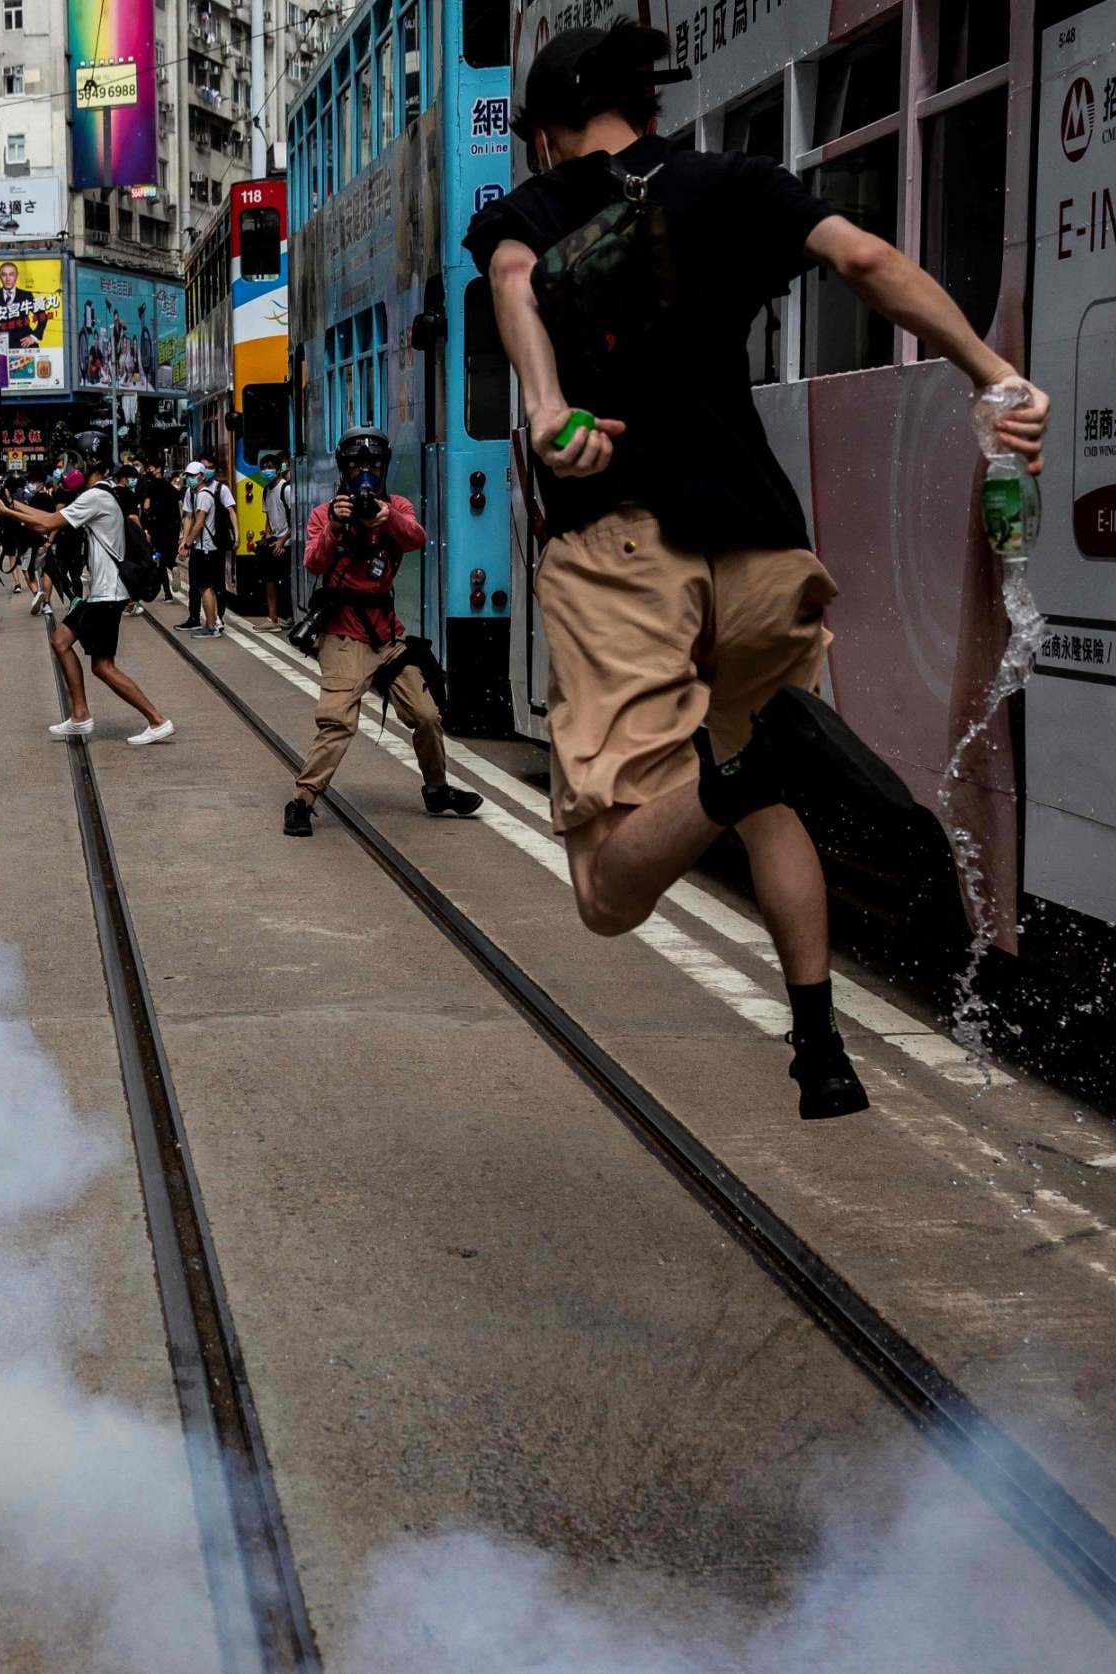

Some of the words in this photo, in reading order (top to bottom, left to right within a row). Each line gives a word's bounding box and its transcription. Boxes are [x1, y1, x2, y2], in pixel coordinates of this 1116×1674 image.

[1058, 27, 1076, 48] 5:48
[108, 84, 136, 98] 6988
[472, 99, 508, 136] 網
[471, 144, 508, 154] Online
[240, 190, 262, 204] 118
[1042, 632, 1105, 664] 招商永隆保險
